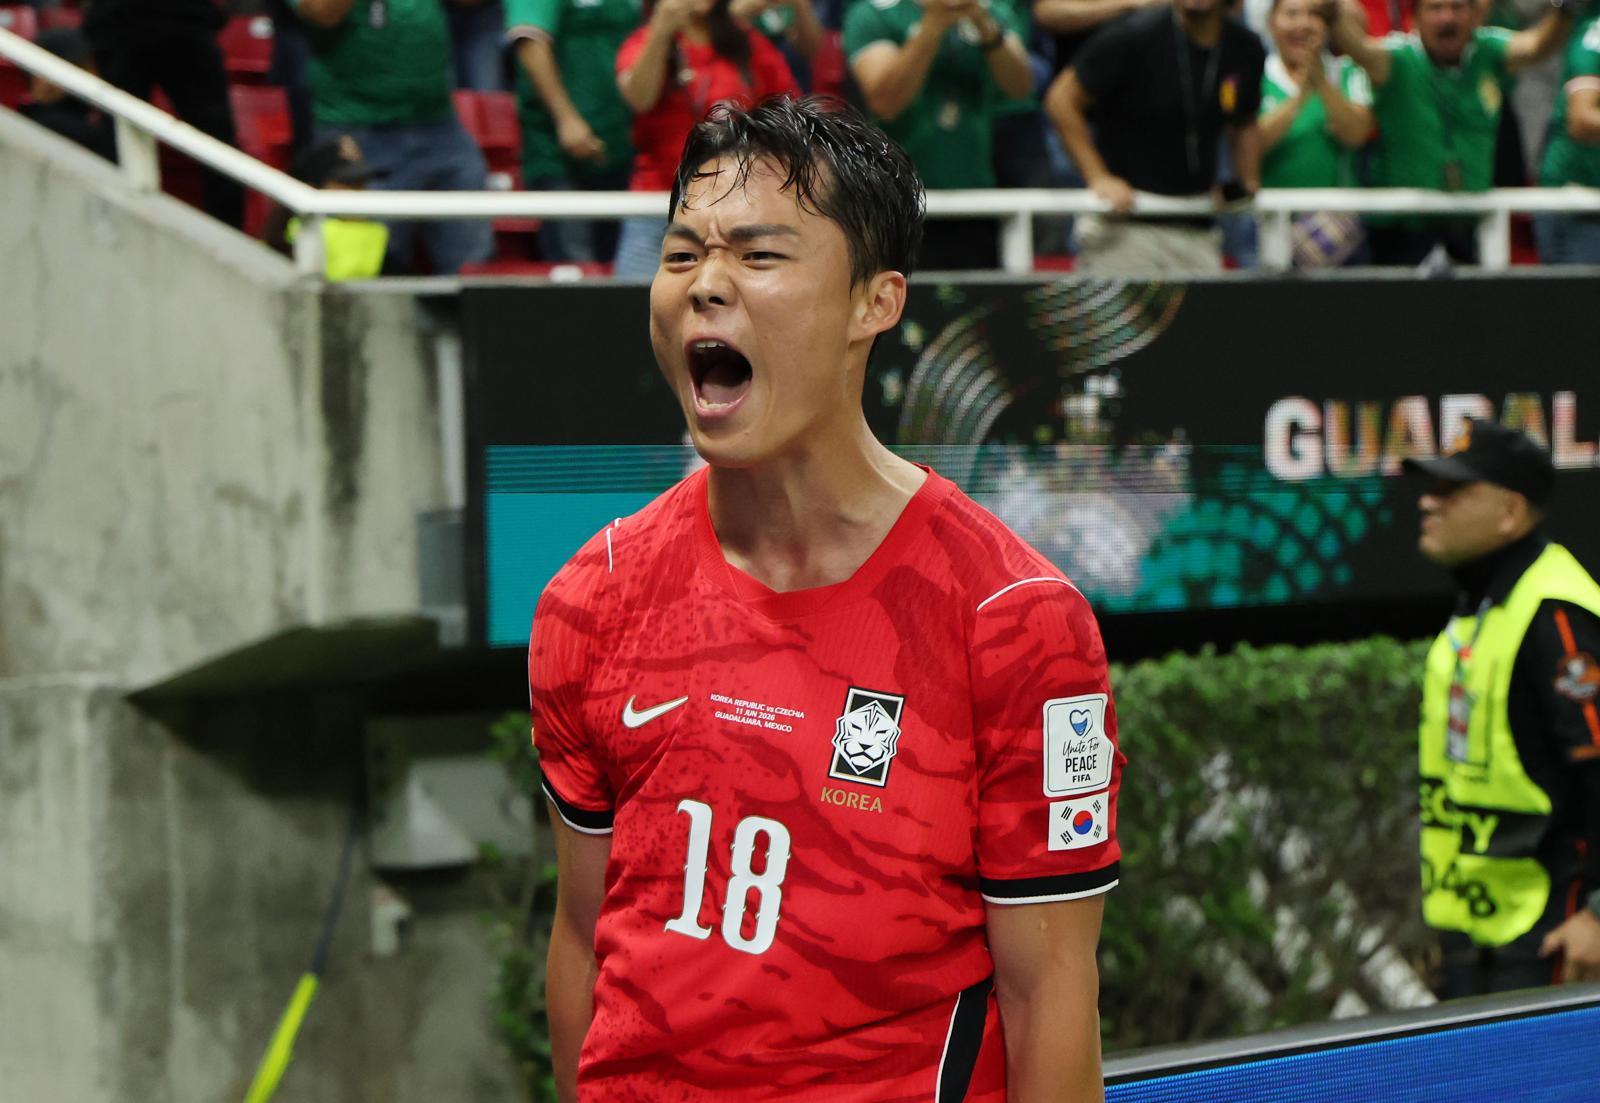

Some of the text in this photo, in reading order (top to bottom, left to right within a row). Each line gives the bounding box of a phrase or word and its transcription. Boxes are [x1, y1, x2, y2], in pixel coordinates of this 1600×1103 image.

[1264, 390, 1600, 481] GUAAL
[711, 694, 805, 718] KOREA REPUBLIC vs CZECHIA
[735, 707, 775, 721] 11 JUN 2026
[715, 711, 792, 733] GUADALAJARA, MEXICO
[1062, 737, 1100, 756] Unite For
[1066, 754, 1097, 773] PEACE
[1072, 774, 1090, 783] FIFA
[821, 787, 883, 813] KOREA
[664, 799, 792, 955] 18
